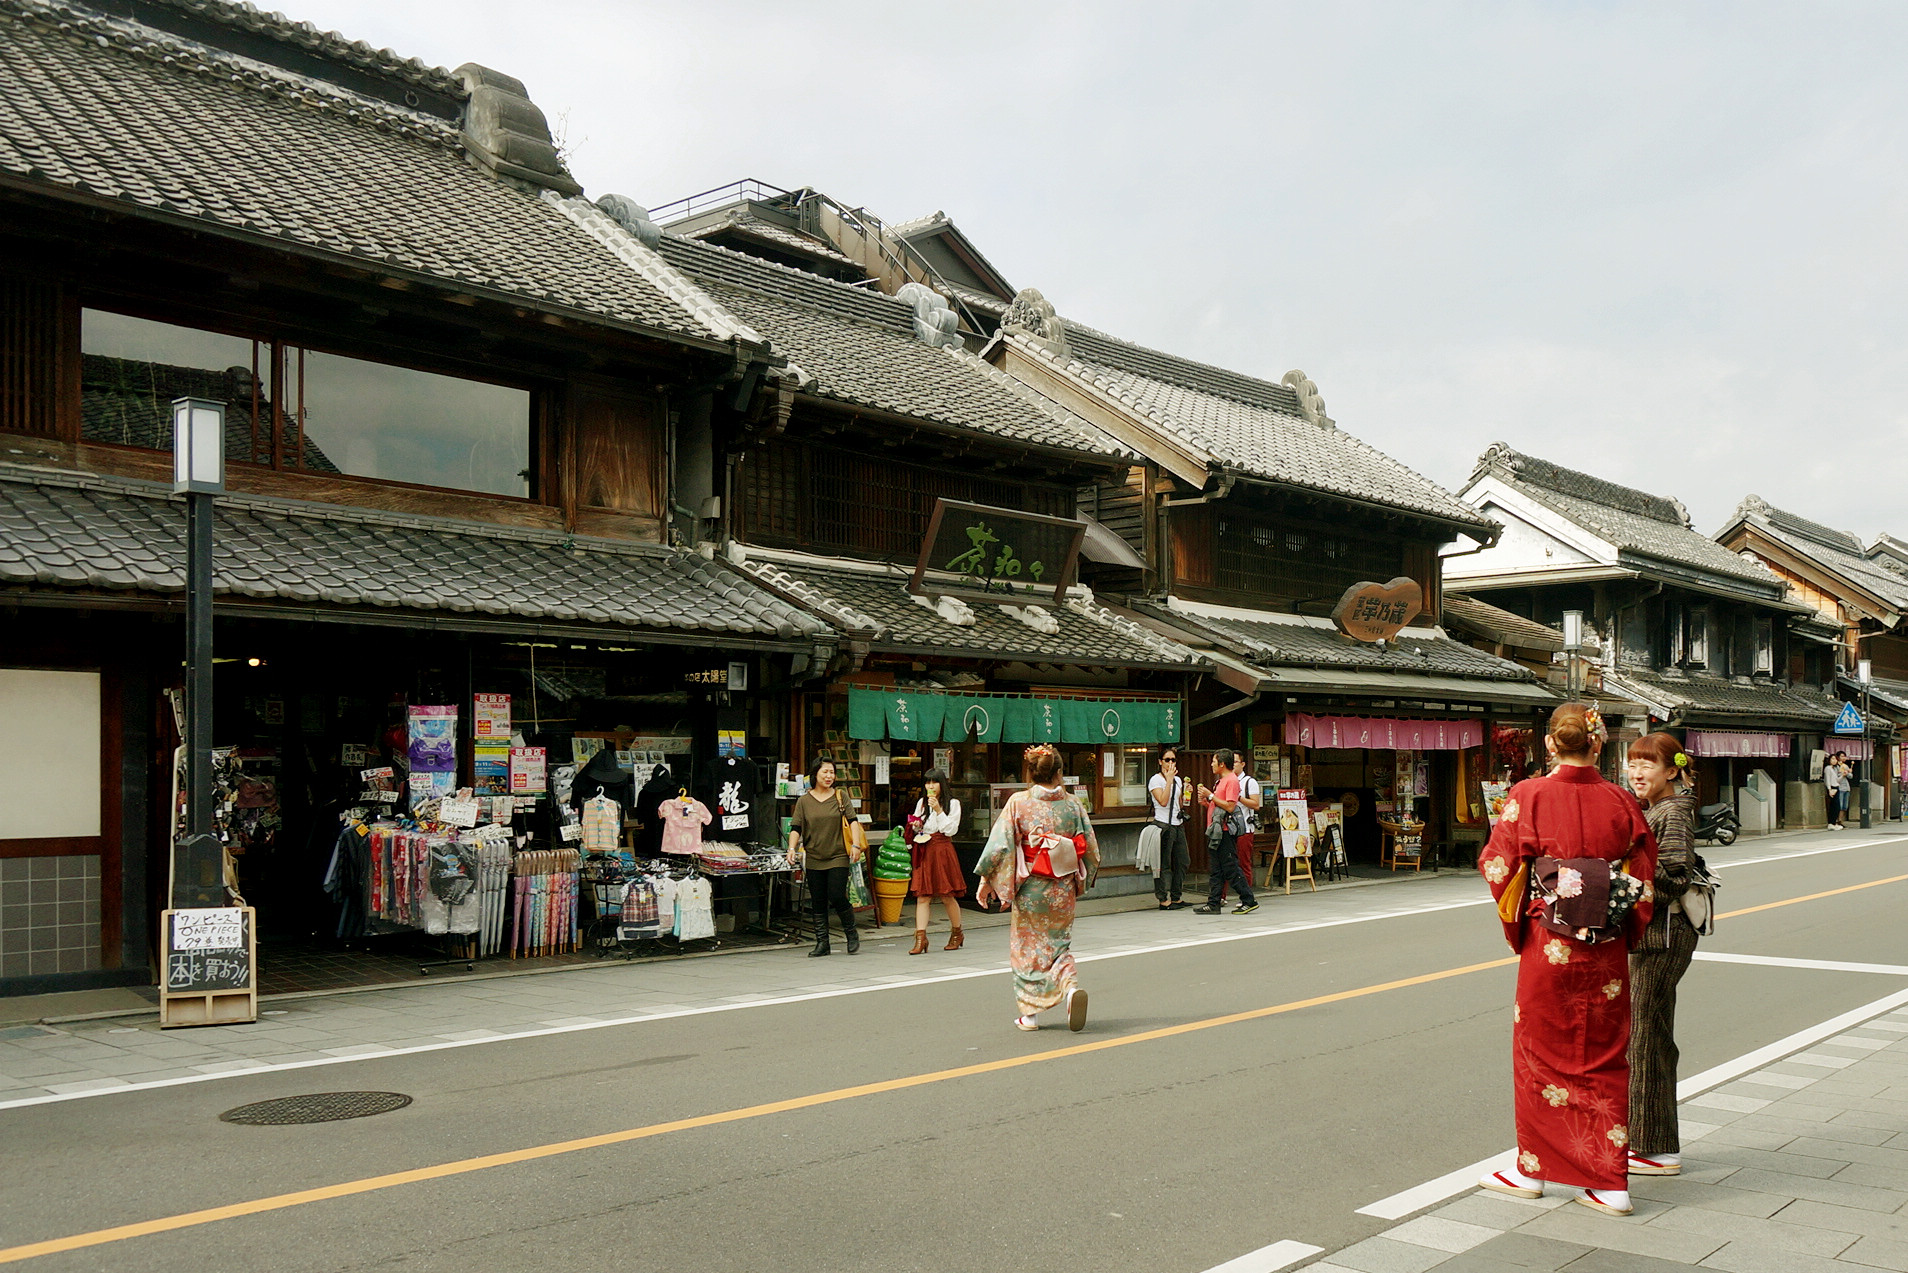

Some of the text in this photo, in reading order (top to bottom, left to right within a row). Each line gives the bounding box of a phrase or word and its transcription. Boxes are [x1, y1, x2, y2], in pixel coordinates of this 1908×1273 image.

[718, 781, 749, 814] 龍
[181, 914, 232, 926] ワンピース
[210, 926, 239, 934] PIECE
